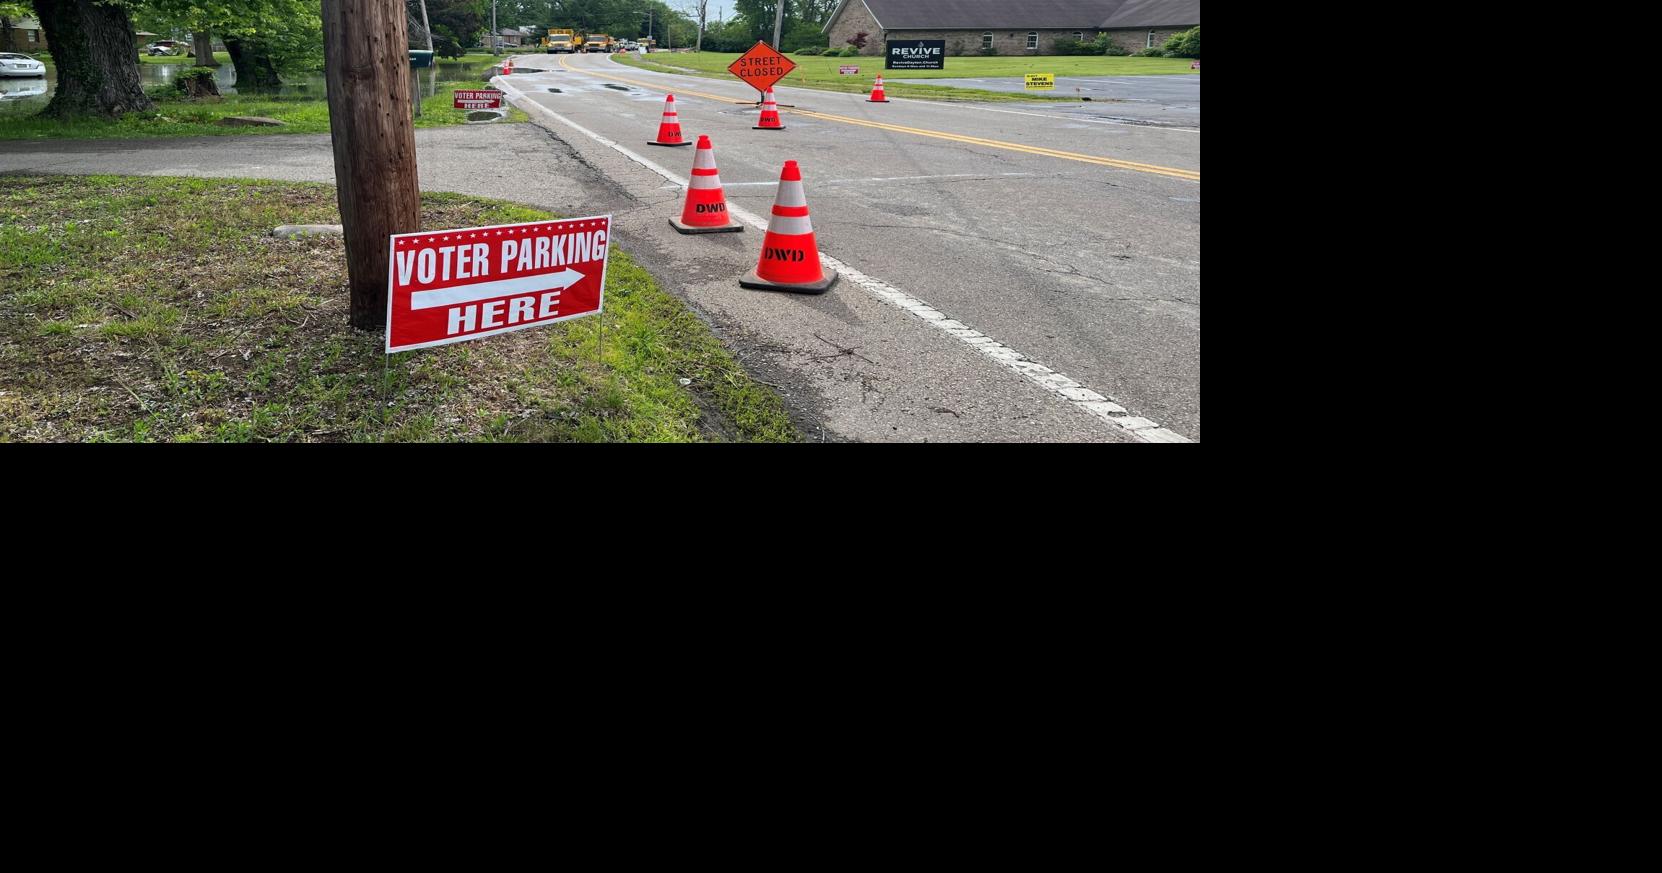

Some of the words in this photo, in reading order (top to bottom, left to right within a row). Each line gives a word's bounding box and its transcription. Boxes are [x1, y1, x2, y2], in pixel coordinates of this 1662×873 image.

[740, 56, 781, 67] STREET
[739, 67, 784, 77] CLOSED
[696, 202, 726, 213] DWD
[396, 242, 489, 286] VOTER
[500, 229, 606, 273] PARKING
[764, 246, 805, 262] DWD
[447, 291, 561, 335] HERE
